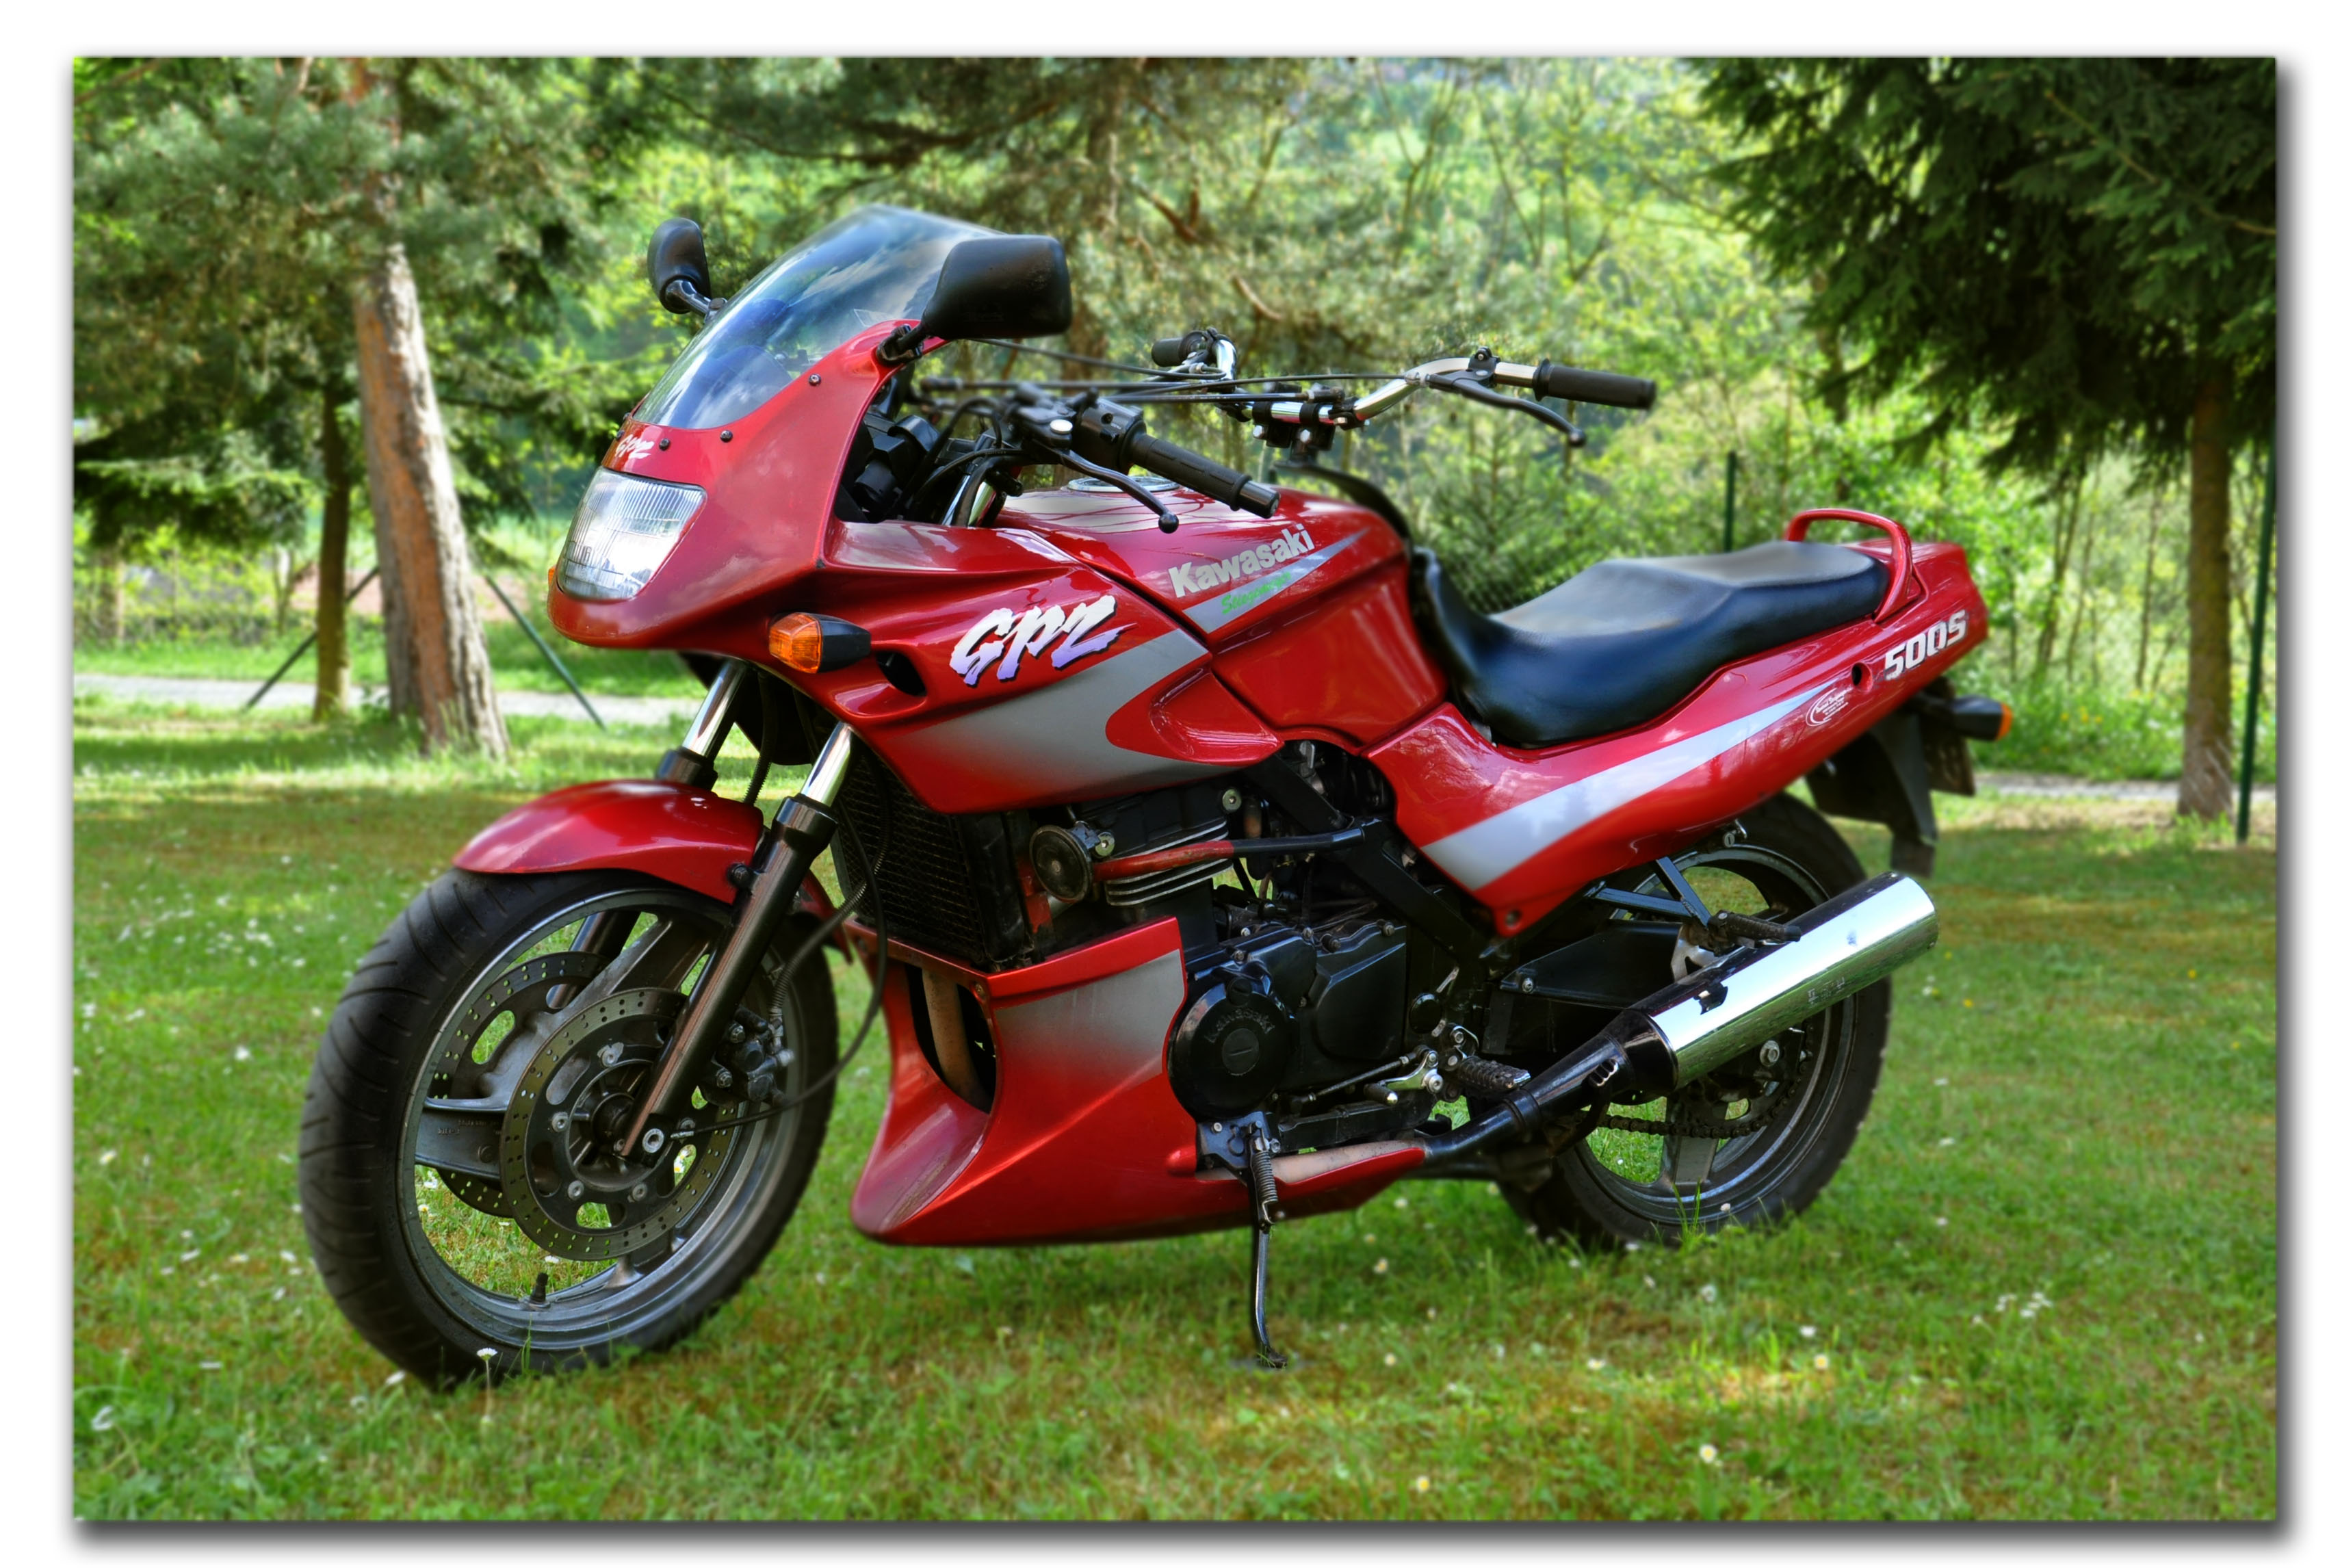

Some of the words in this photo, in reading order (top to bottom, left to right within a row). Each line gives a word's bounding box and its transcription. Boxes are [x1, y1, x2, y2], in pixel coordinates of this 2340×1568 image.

[1168, 523, 1315, 598] Kawasaki
[950, 594, 1137, 687] GPZ
[1884, 609, 1968, 681] 500S
